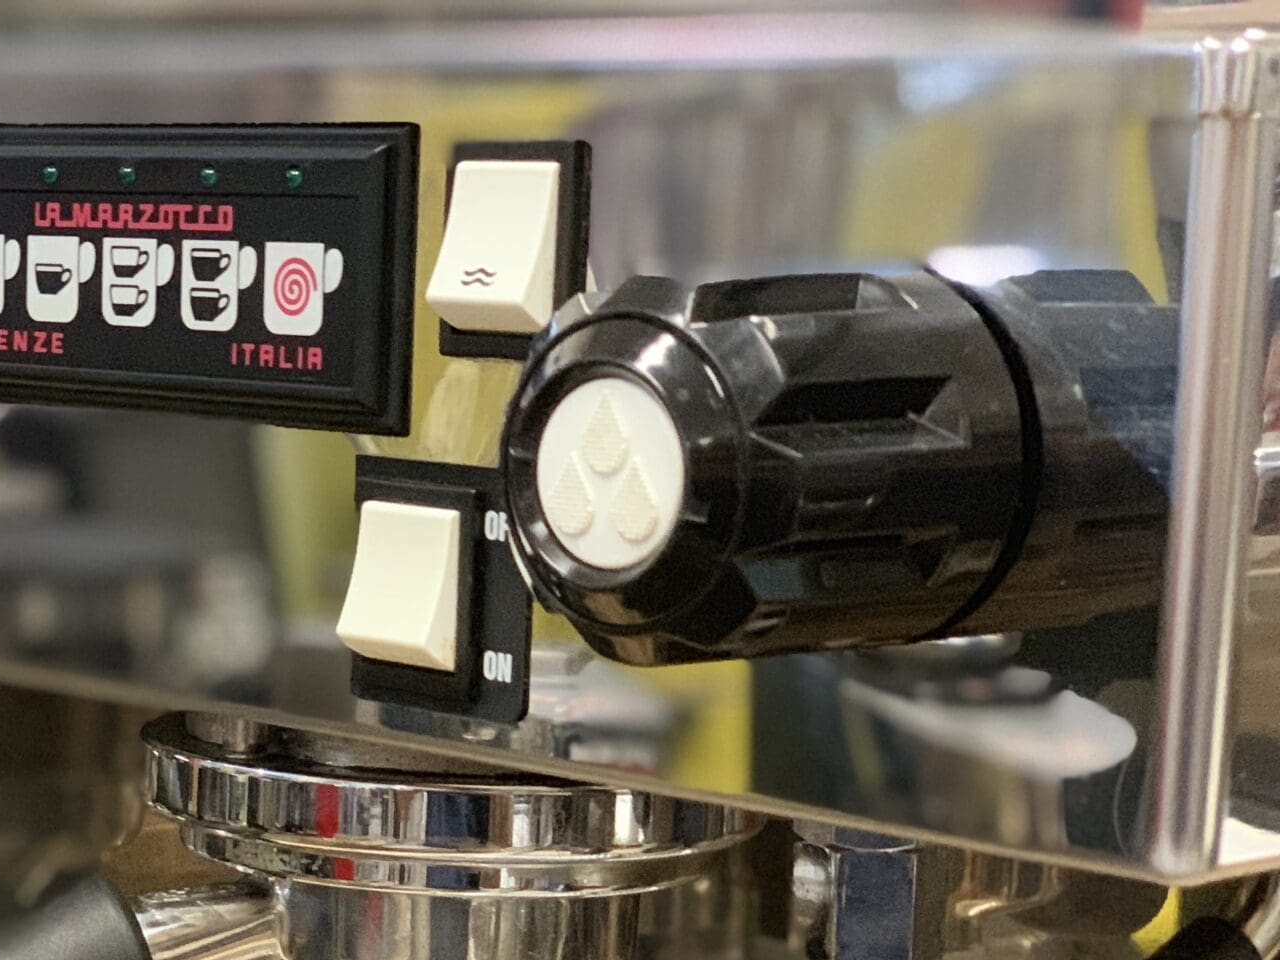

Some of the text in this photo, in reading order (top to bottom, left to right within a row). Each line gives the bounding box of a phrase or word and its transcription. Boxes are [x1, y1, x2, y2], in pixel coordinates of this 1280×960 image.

[34, 202, 234, 231] LA MARZOCCO
[231, 342, 323, 370] ITALIA
[483, 650, 513, 683] ON
